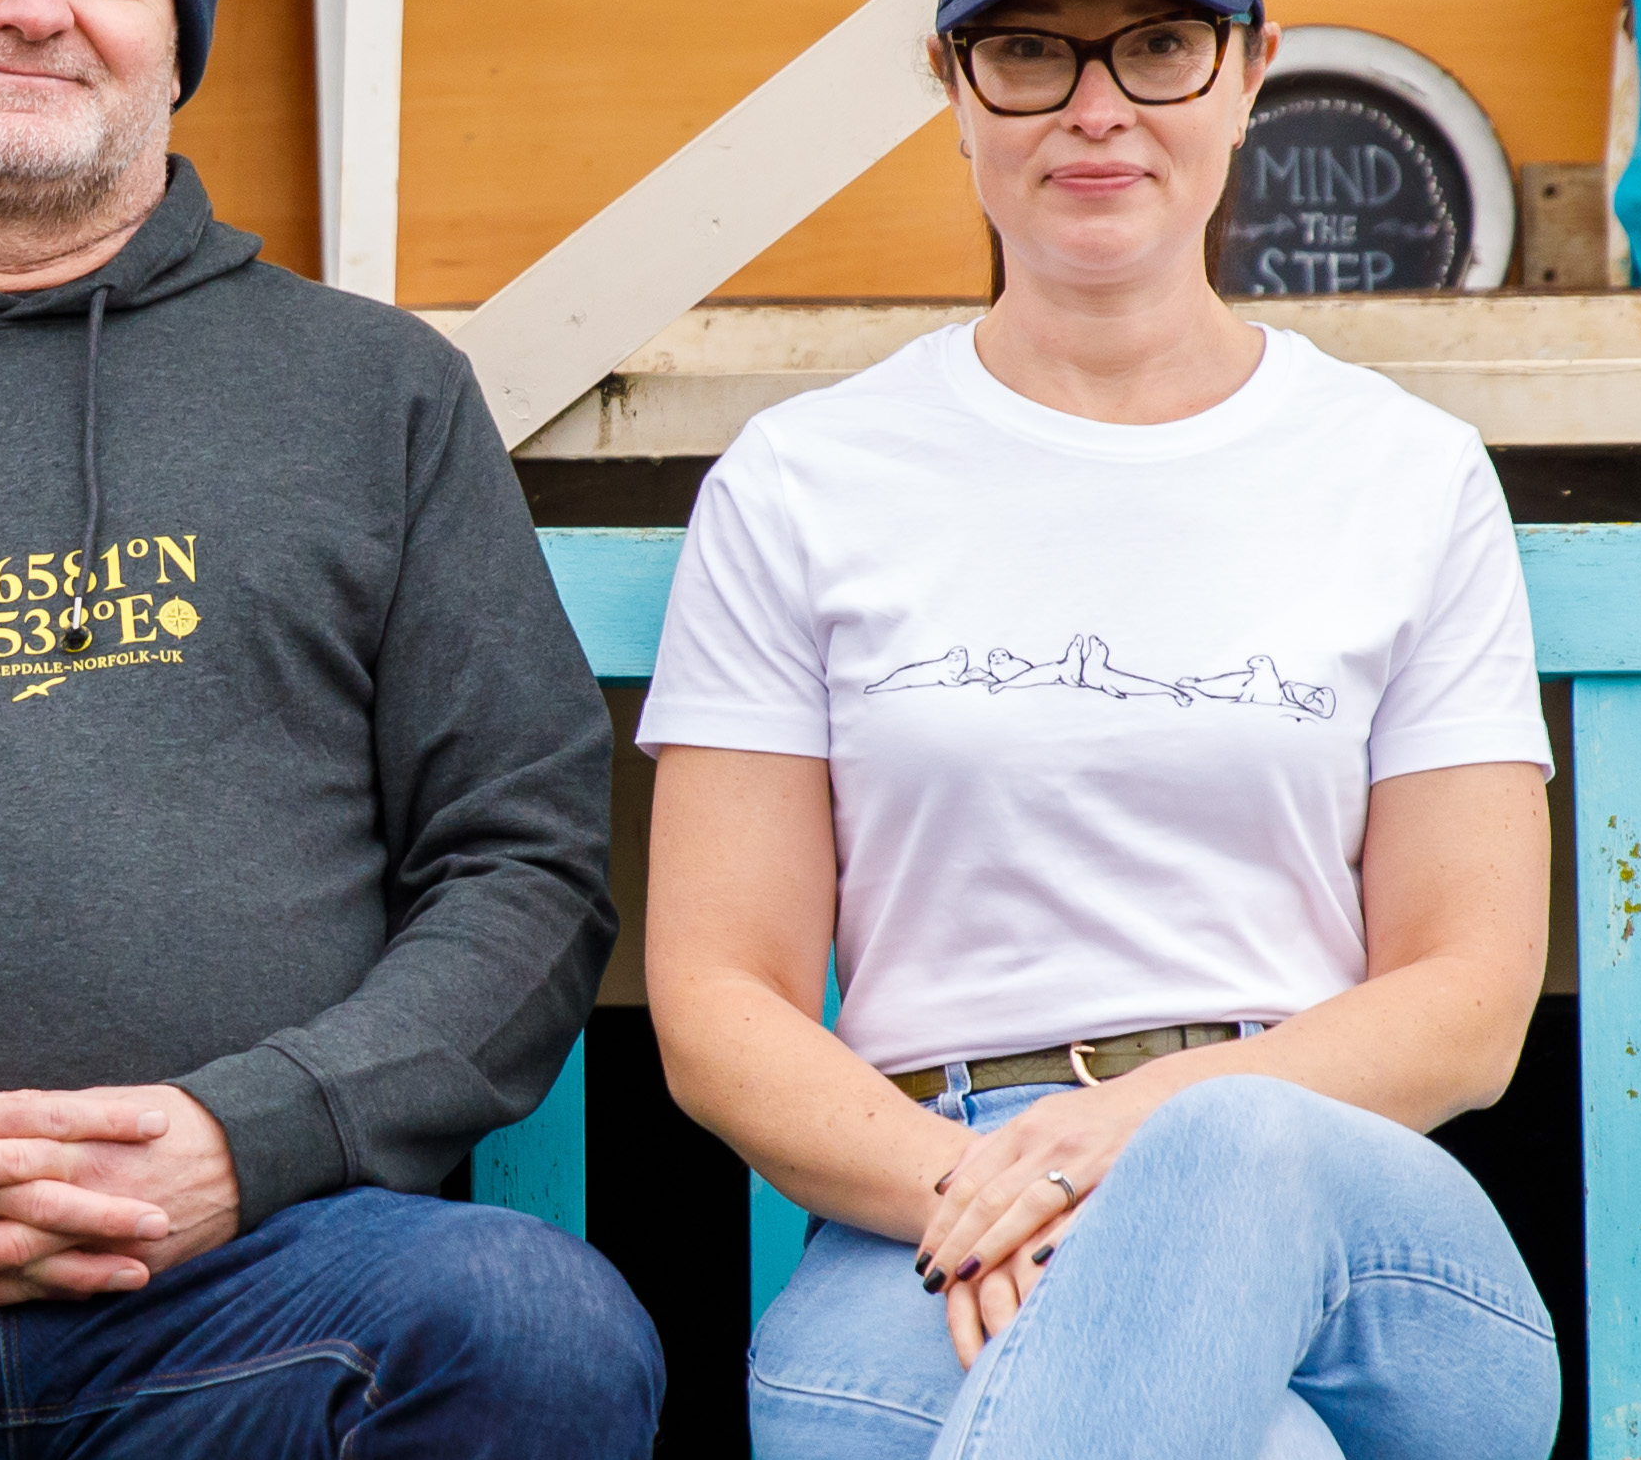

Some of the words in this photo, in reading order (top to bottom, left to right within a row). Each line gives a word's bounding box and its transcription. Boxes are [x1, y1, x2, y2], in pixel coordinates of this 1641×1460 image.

[1255, 144, 1402, 206] MIND
[1299, 212, 1358, 245] THE
[1253, 247, 1395, 294] STEP
